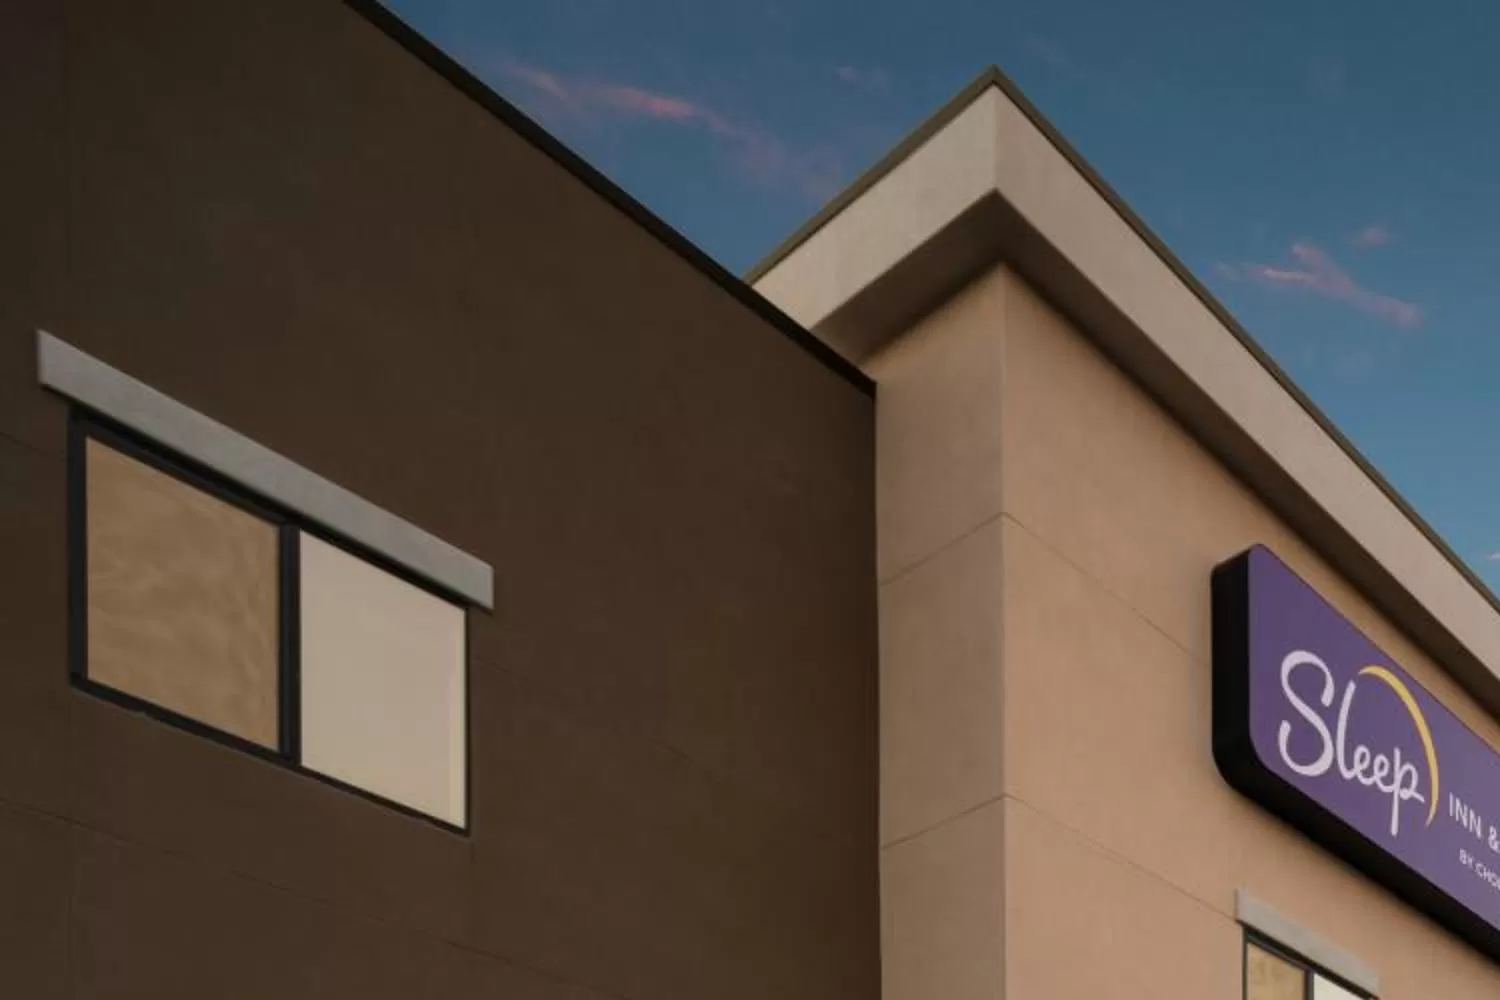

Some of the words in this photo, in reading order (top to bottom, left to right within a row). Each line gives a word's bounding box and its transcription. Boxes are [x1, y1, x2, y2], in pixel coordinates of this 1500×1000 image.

[1278, 650, 1424, 836] Sleep
[1449, 792, 1482, 839] INN
[1488, 825, 1500, 853] &
[1460, 848, 1474, 868] BY
